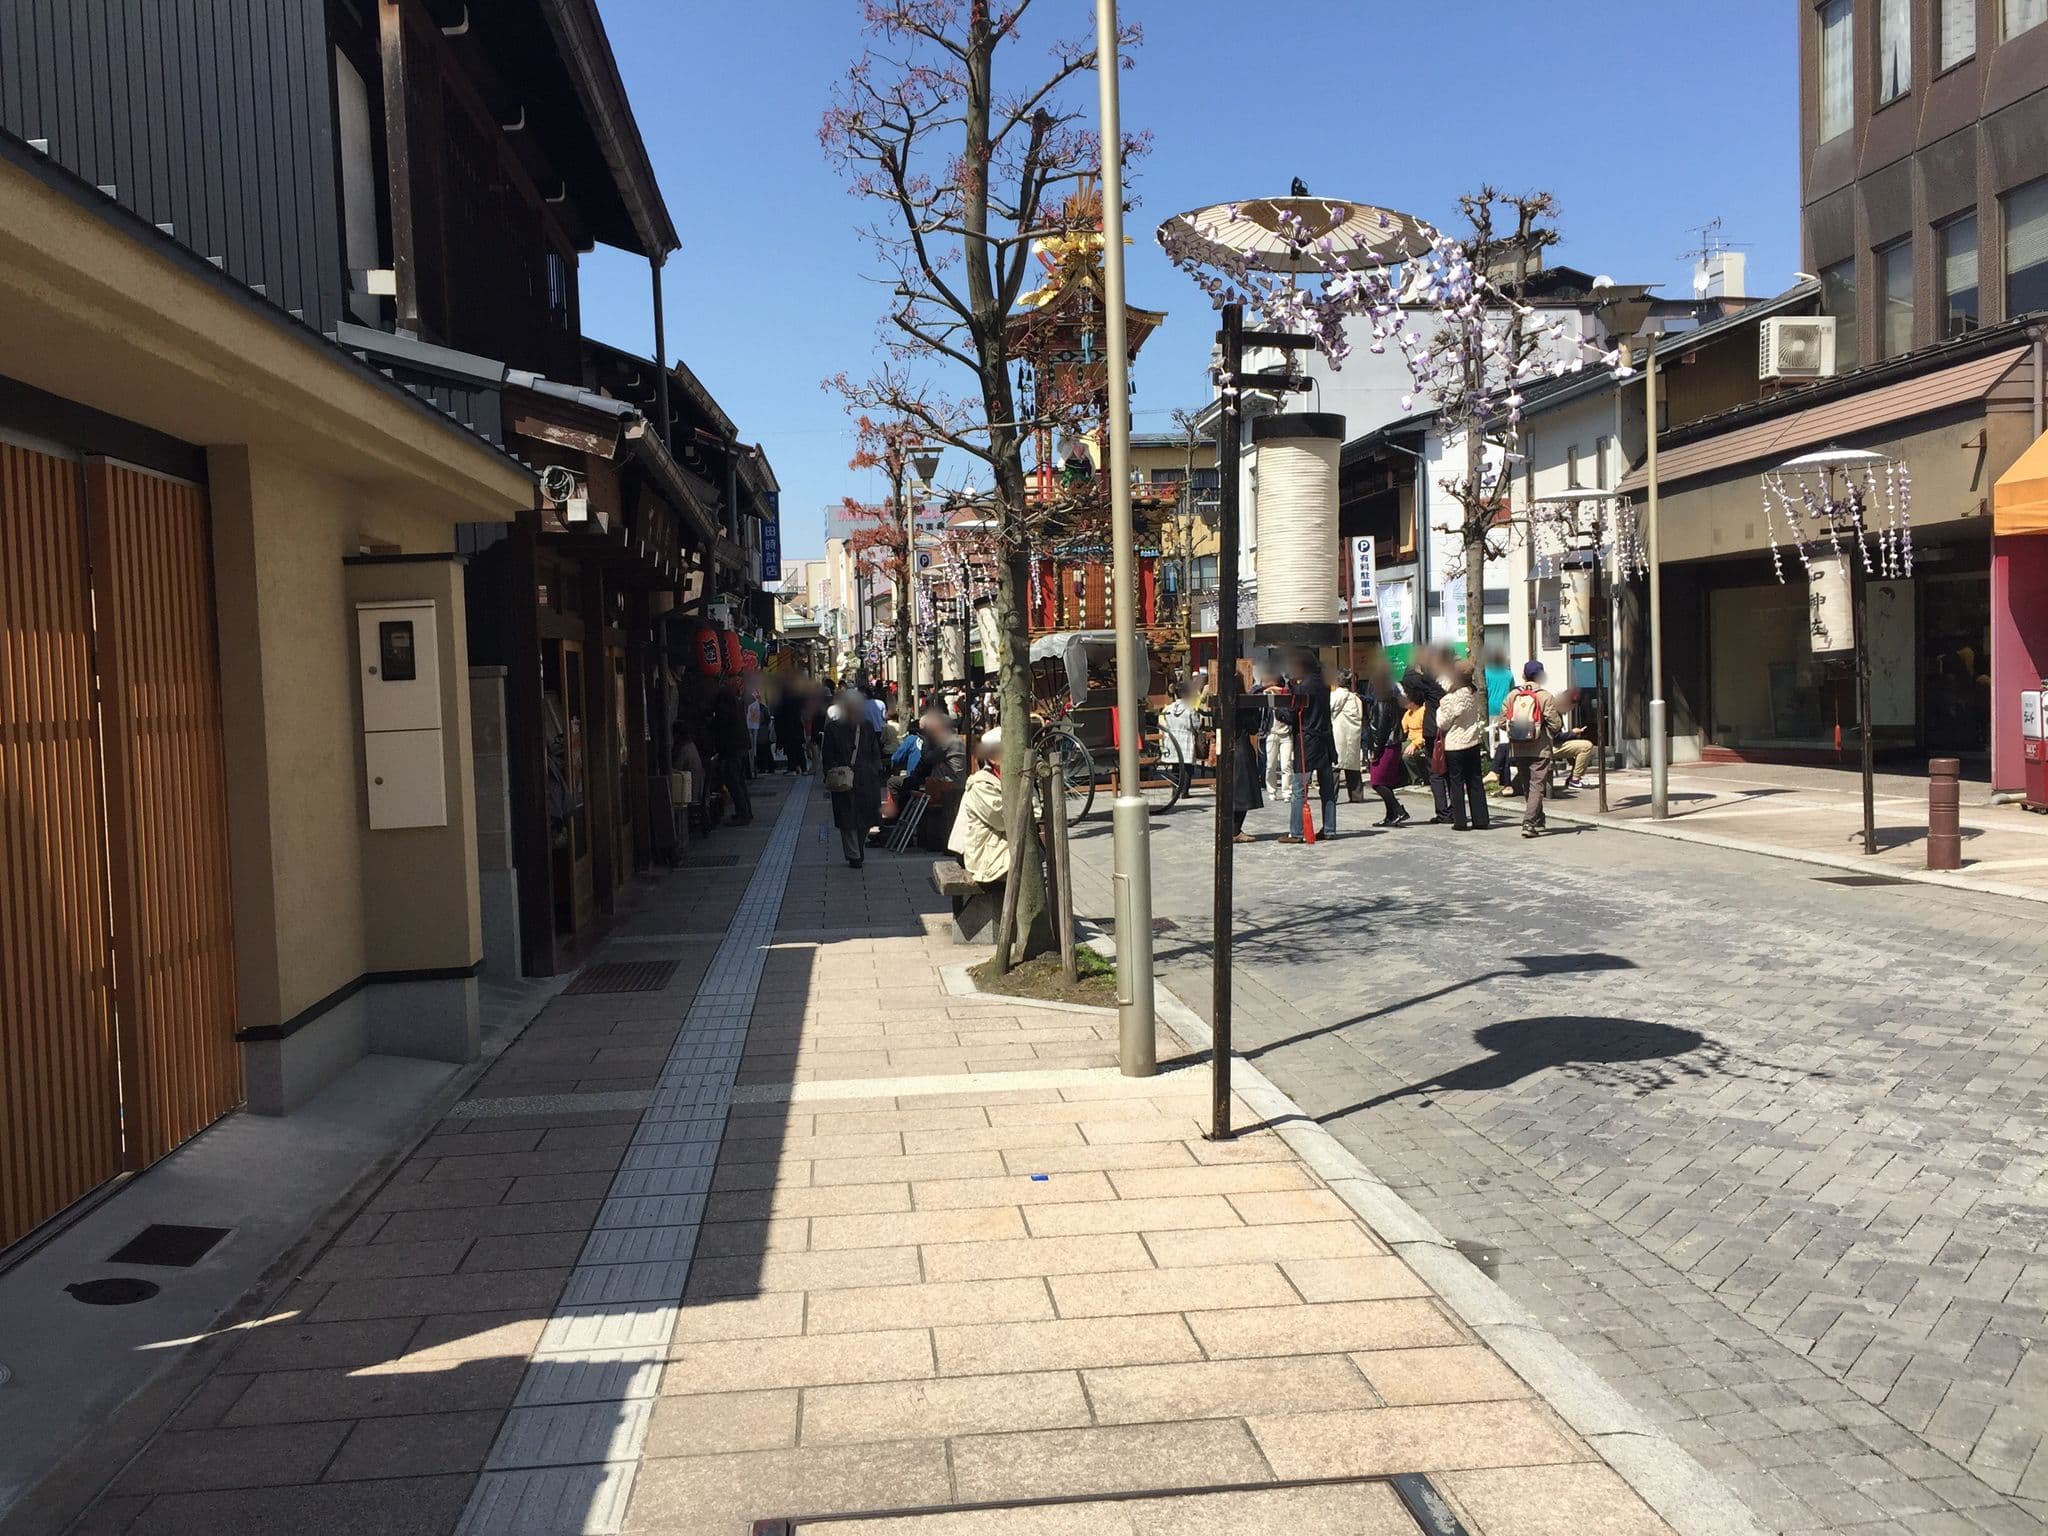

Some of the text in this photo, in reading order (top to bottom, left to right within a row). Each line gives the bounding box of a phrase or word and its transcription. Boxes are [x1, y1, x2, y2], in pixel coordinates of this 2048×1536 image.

[1360, 541, 1369, 552] P
[1360, 554, 1371, 597] 有料駐車場
